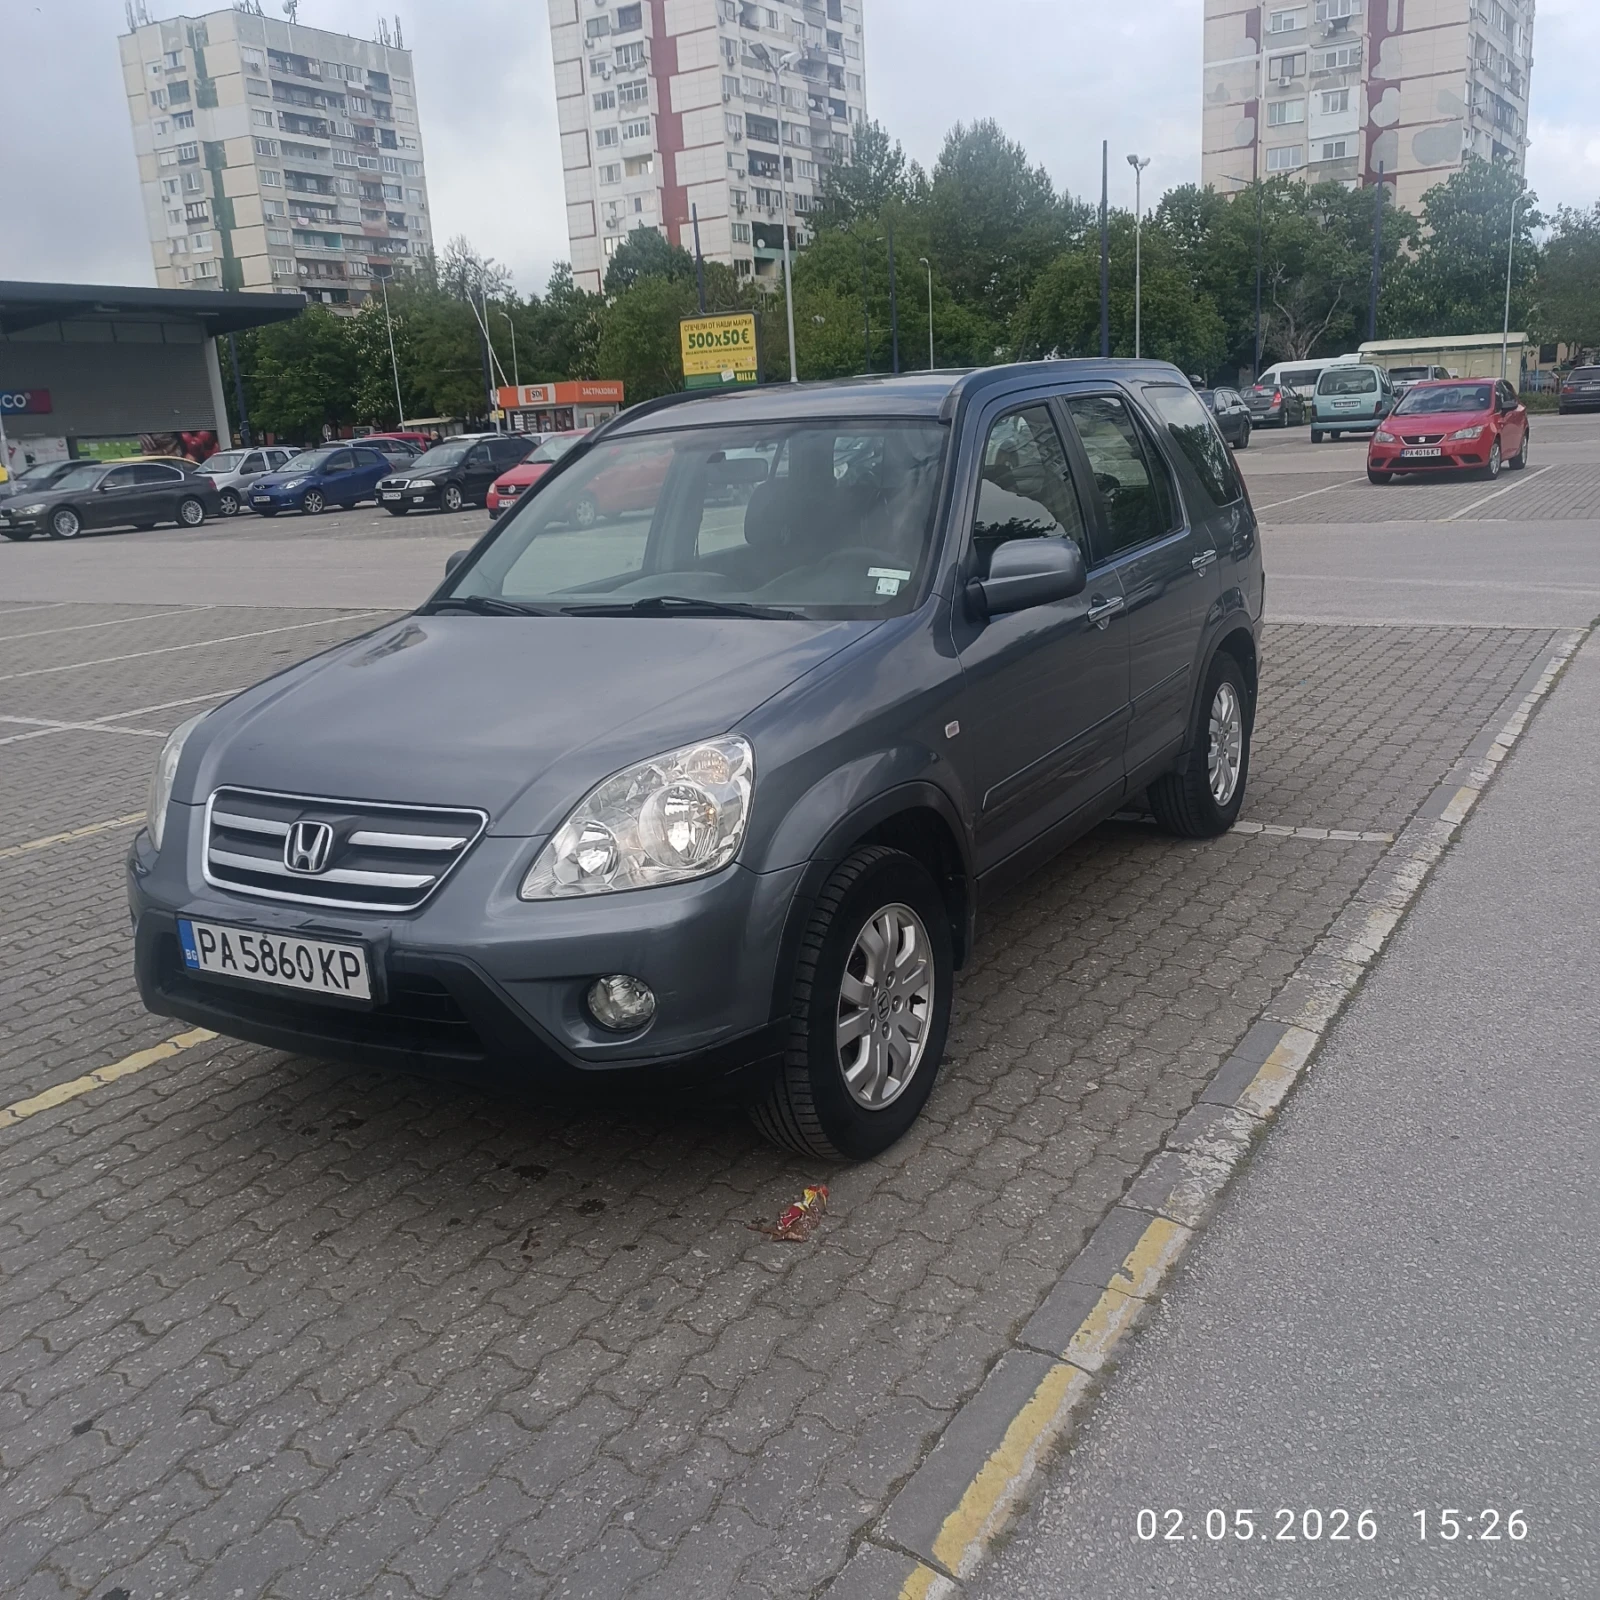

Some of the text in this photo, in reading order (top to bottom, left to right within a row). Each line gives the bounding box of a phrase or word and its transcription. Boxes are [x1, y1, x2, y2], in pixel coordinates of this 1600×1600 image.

[736, 372, 757, 382] BILLA
[582, 387, 618, 396] ЗАСТРАХОВКИ
[0, 394, 27, 408] CO
[185, 948, 198, 961] BG
